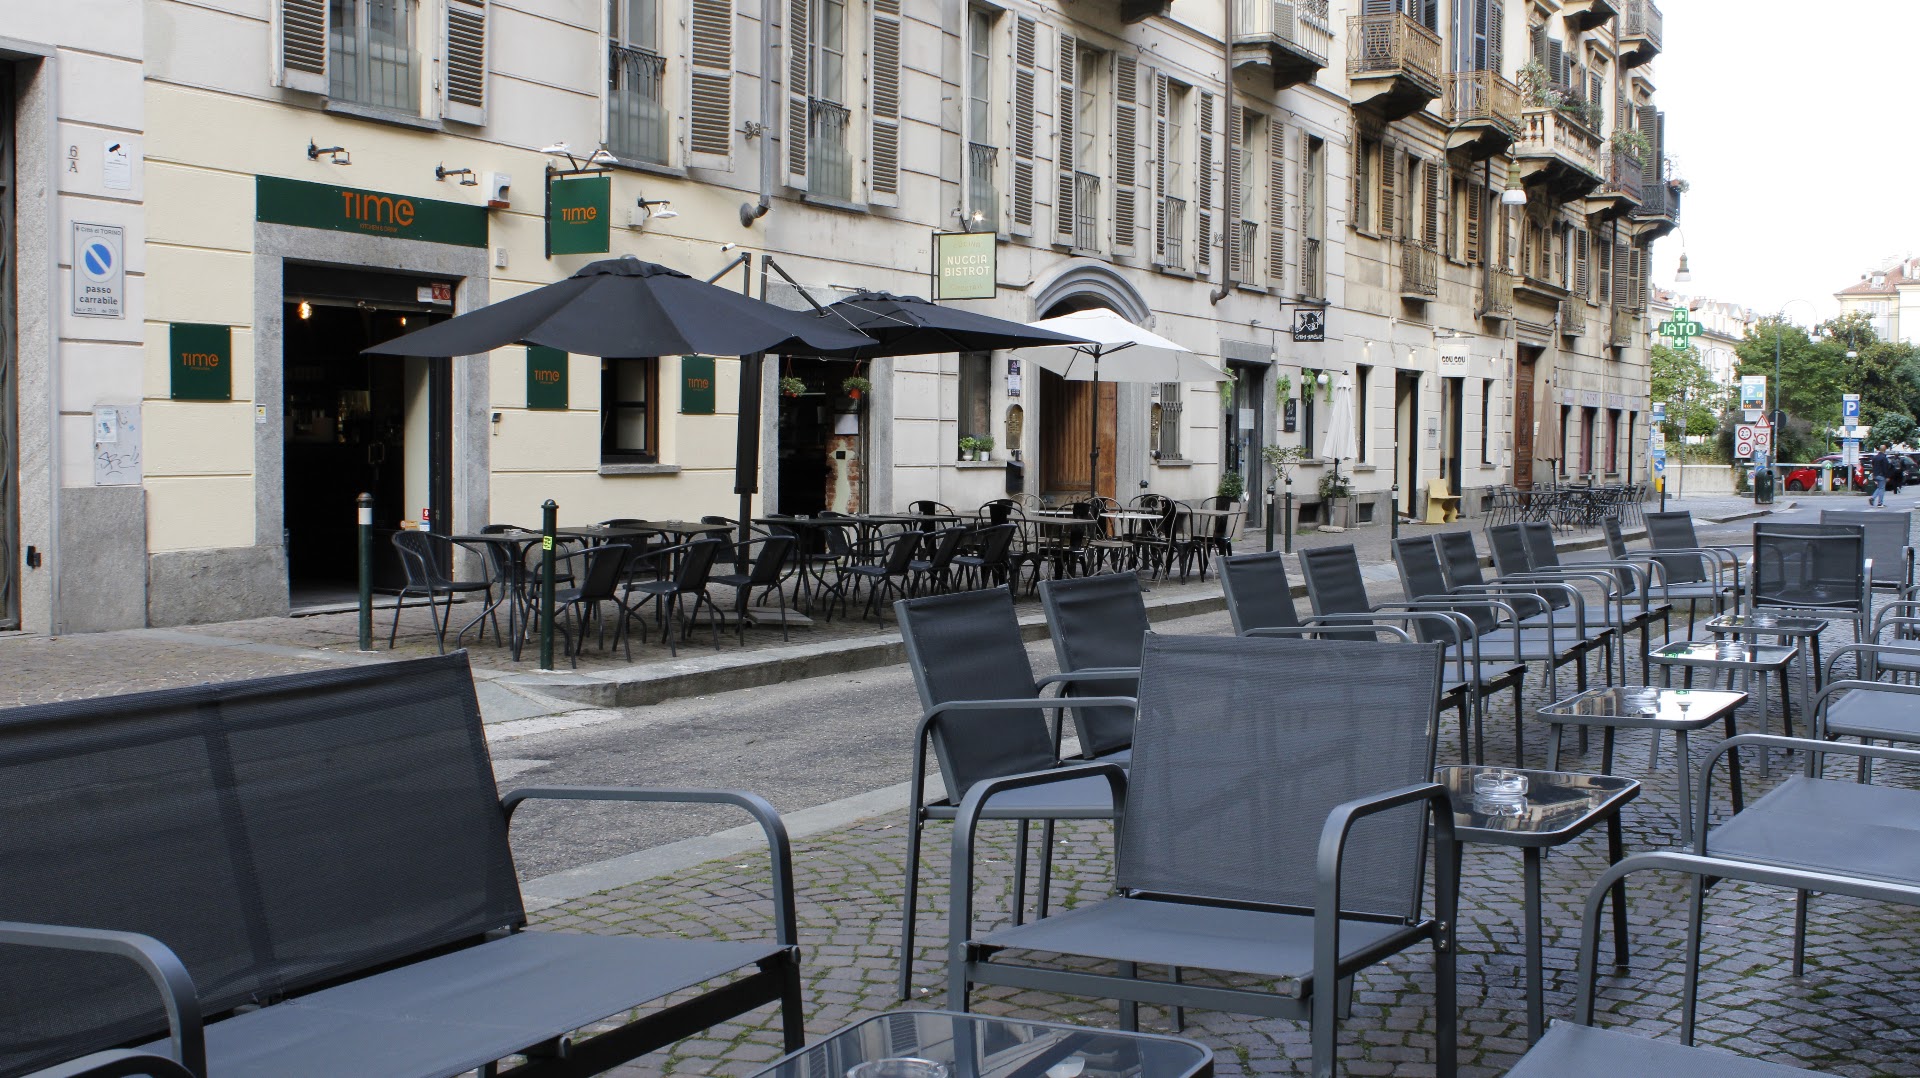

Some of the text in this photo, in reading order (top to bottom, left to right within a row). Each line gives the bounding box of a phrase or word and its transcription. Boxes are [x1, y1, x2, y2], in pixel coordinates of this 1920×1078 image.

[69, 145, 79, 158] 6
[68, 160, 79, 174] A
[947, 254, 988, 266] NUCCIA
[944, 265, 991, 277] BISTROT
[86, 286, 112, 294] passo
[79, 296, 119, 305] carrabile
[1846, 401, 1856, 415] P
